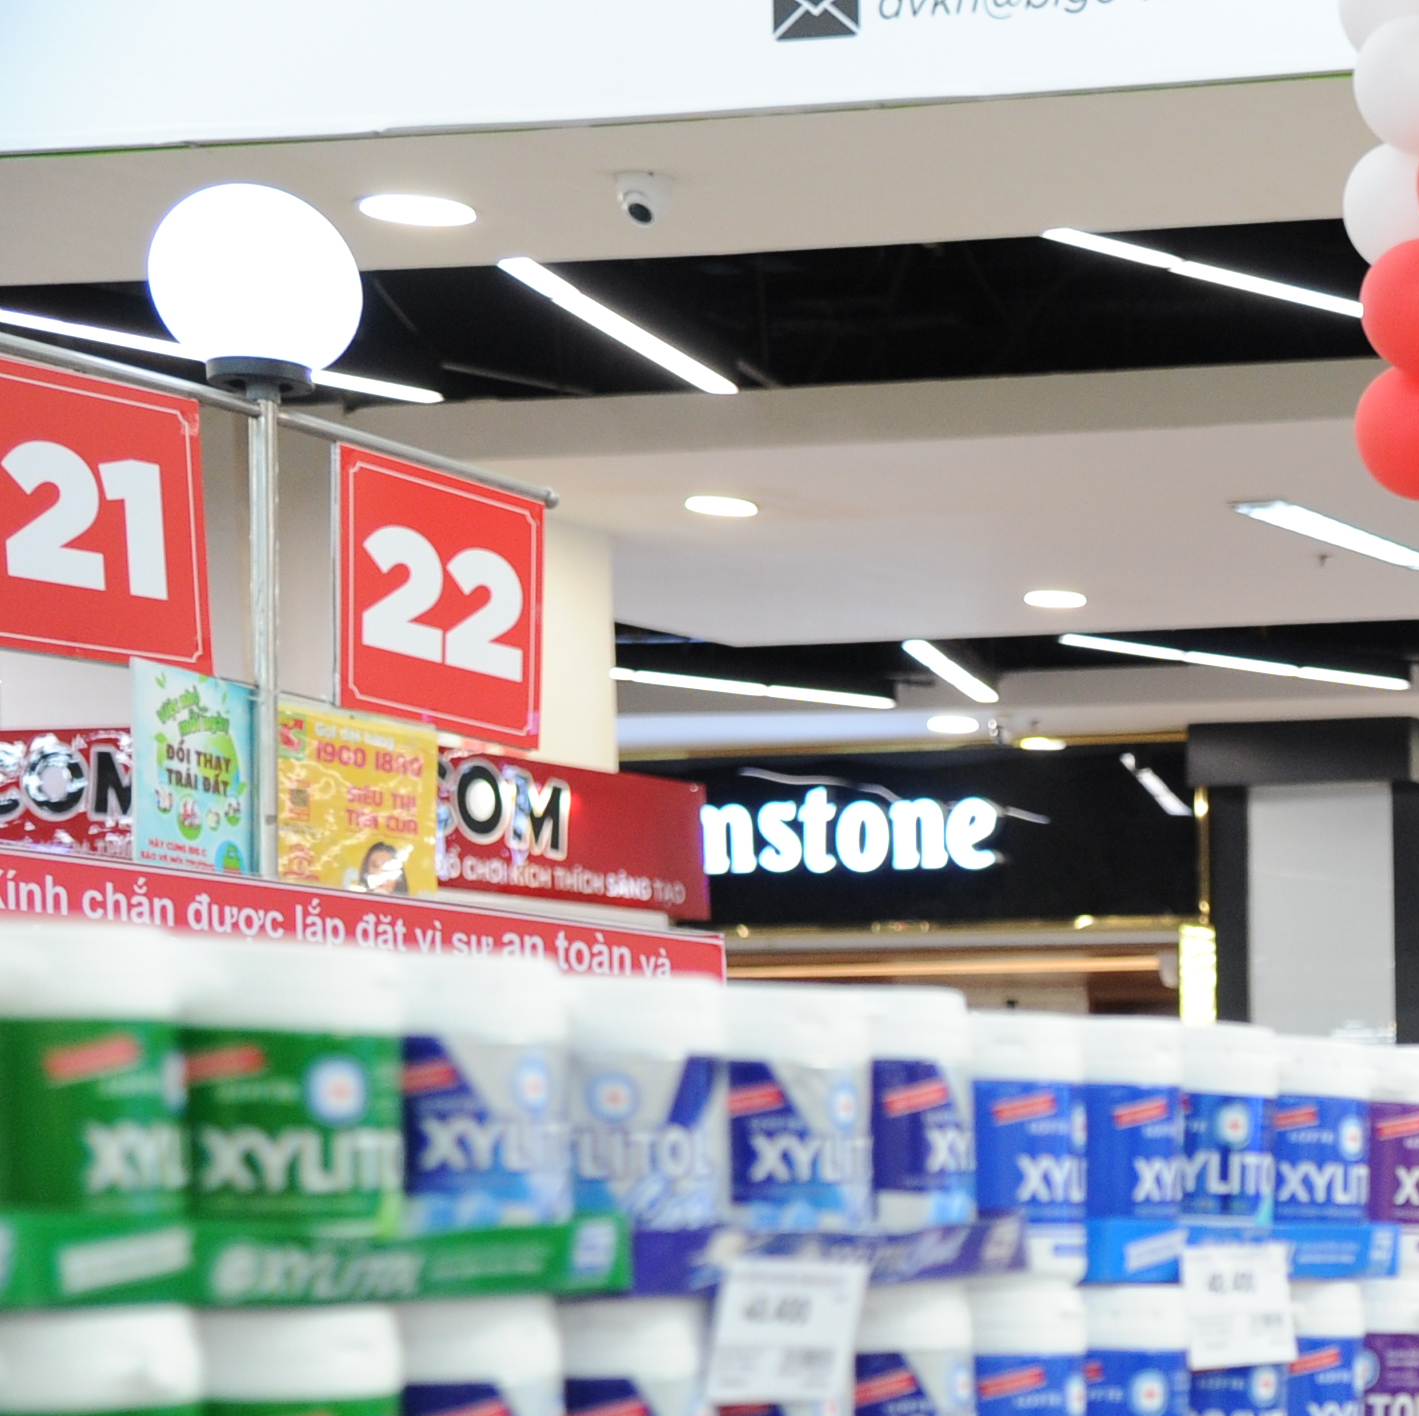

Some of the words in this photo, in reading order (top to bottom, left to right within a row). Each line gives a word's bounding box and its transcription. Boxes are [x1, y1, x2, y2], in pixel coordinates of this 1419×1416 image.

[0, 440, 169, 601] 21
[362, 525, 524, 684] 22
[166, 766, 199, 792] TRÁI
[195, 750, 232, 773] THAY
[438, 757, 571, 861] OM
[700, 786, 998, 875] nstone
[0, 869, 68, 916] ính
[82, 876, 175, 927] chắn
[187, 893, 284, 942] được
[295, 898, 345, 948] lắp
[555, 930, 632, 976] toàn
